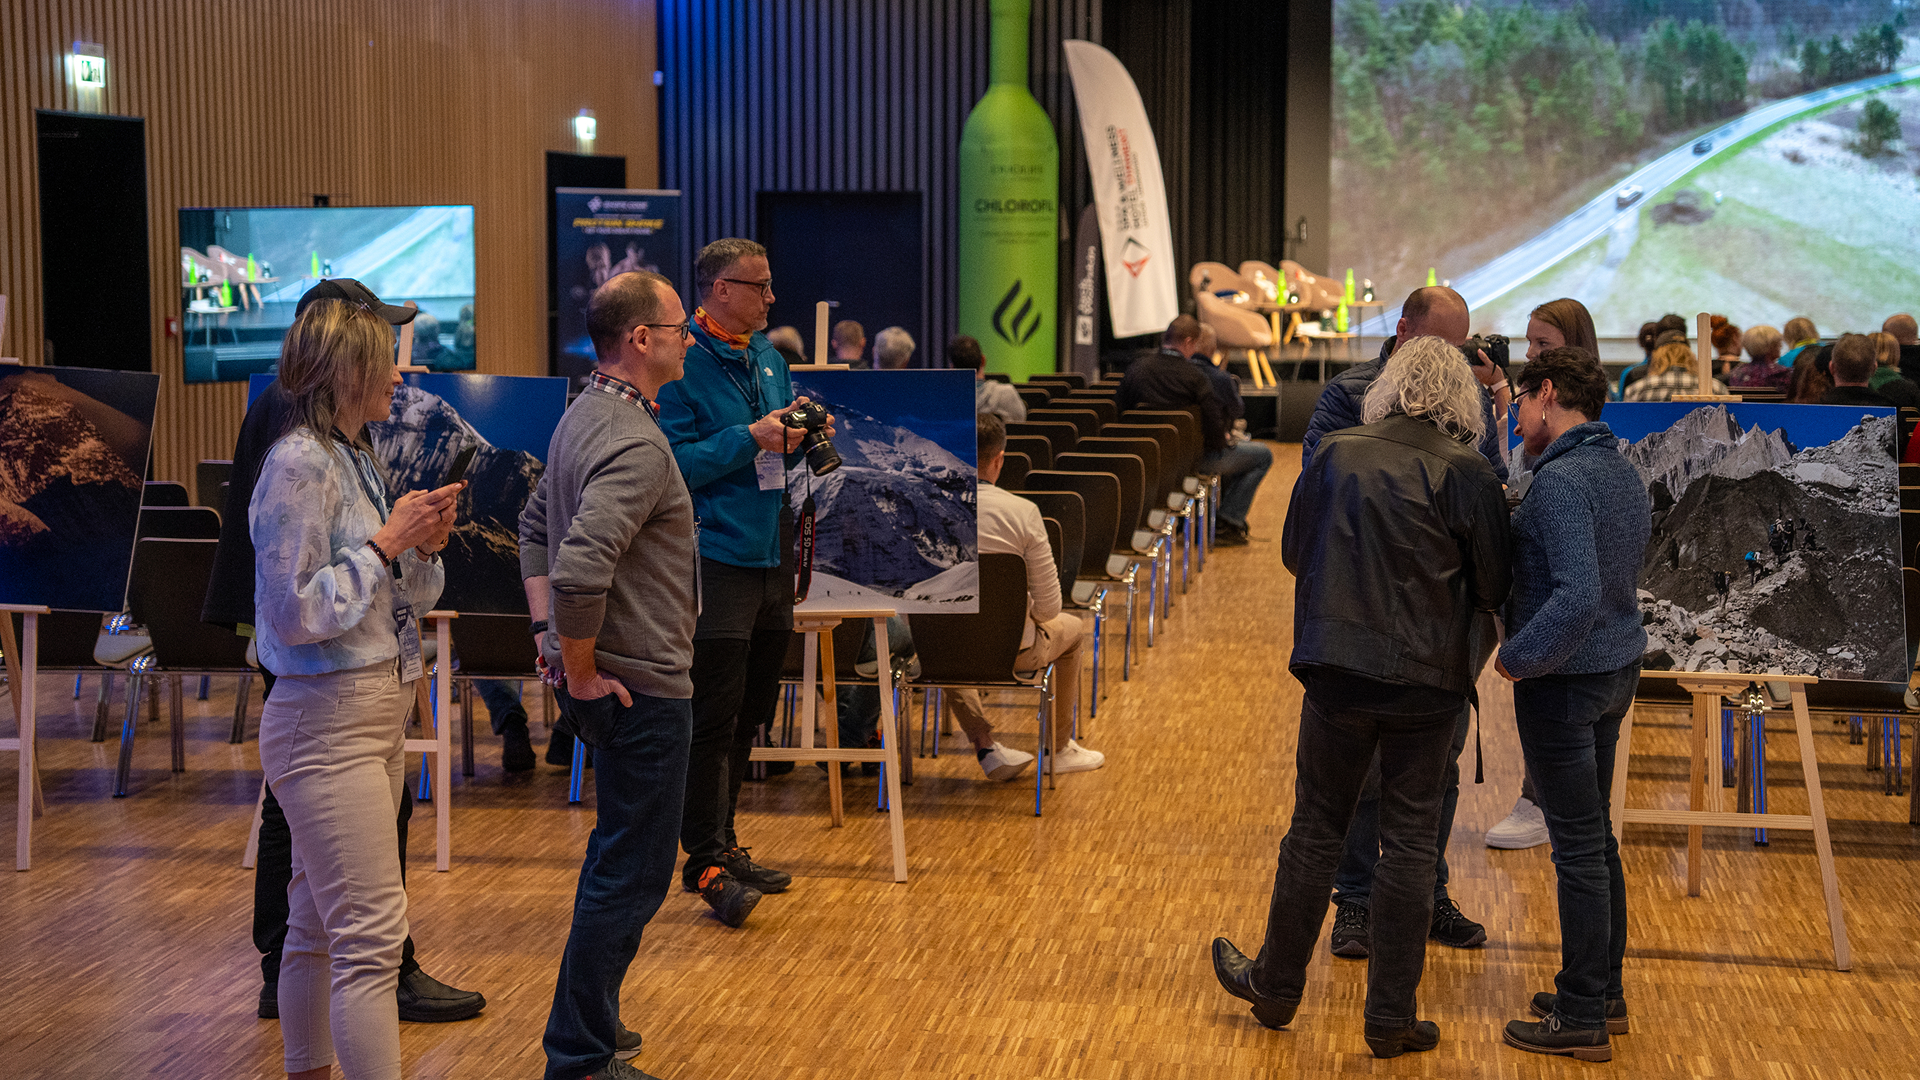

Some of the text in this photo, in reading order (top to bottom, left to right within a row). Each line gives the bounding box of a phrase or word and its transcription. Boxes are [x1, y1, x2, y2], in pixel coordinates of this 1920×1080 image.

[1105, 125, 1126, 192] WELLNESS
[1128, 189, 1141, 229] HOTEL
[804, 516, 812, 535] EOS
[803, 537, 811, 547] 5D
